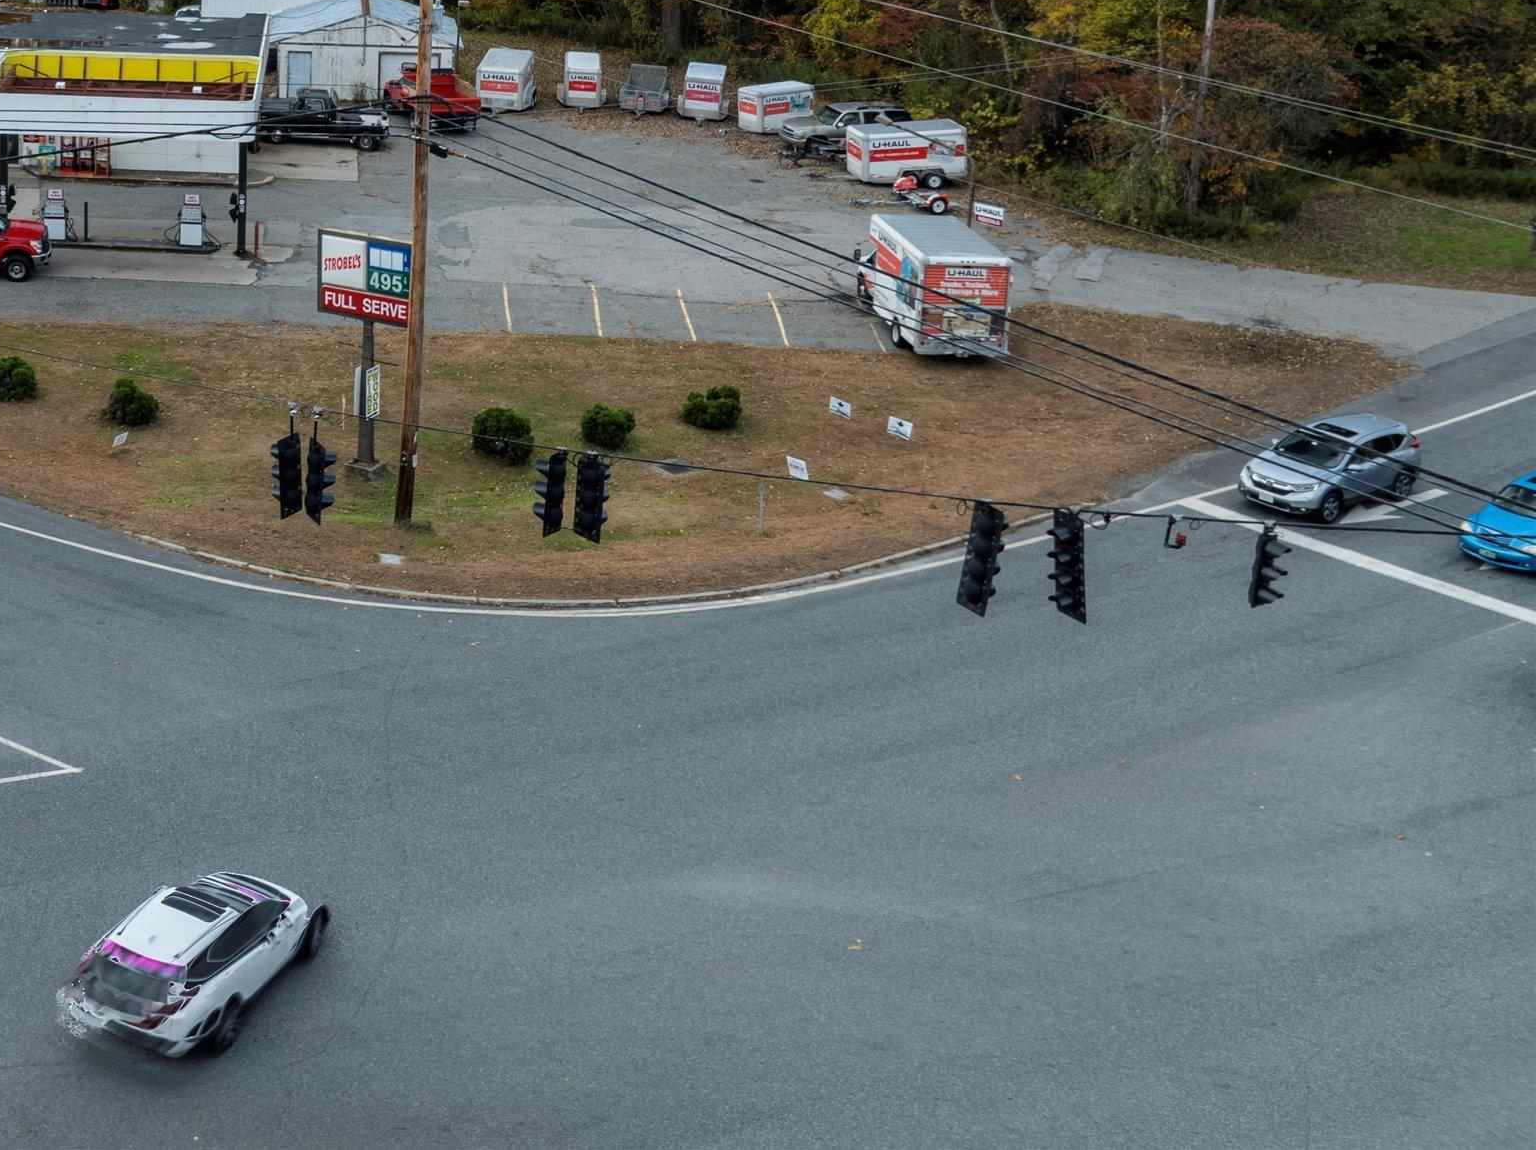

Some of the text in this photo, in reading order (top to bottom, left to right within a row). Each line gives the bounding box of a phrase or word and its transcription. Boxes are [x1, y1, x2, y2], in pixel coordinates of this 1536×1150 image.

[482, 73, 517, 82] U-HAUL
[872, 139, 911, 149] U-HAUL
[976, 205, 1003, 217] U-HAUL
[323, 253, 361, 271] STROBEL'S
[369, 271, 402, 293] 495
[324, 291, 407, 320] FULL SERVE
